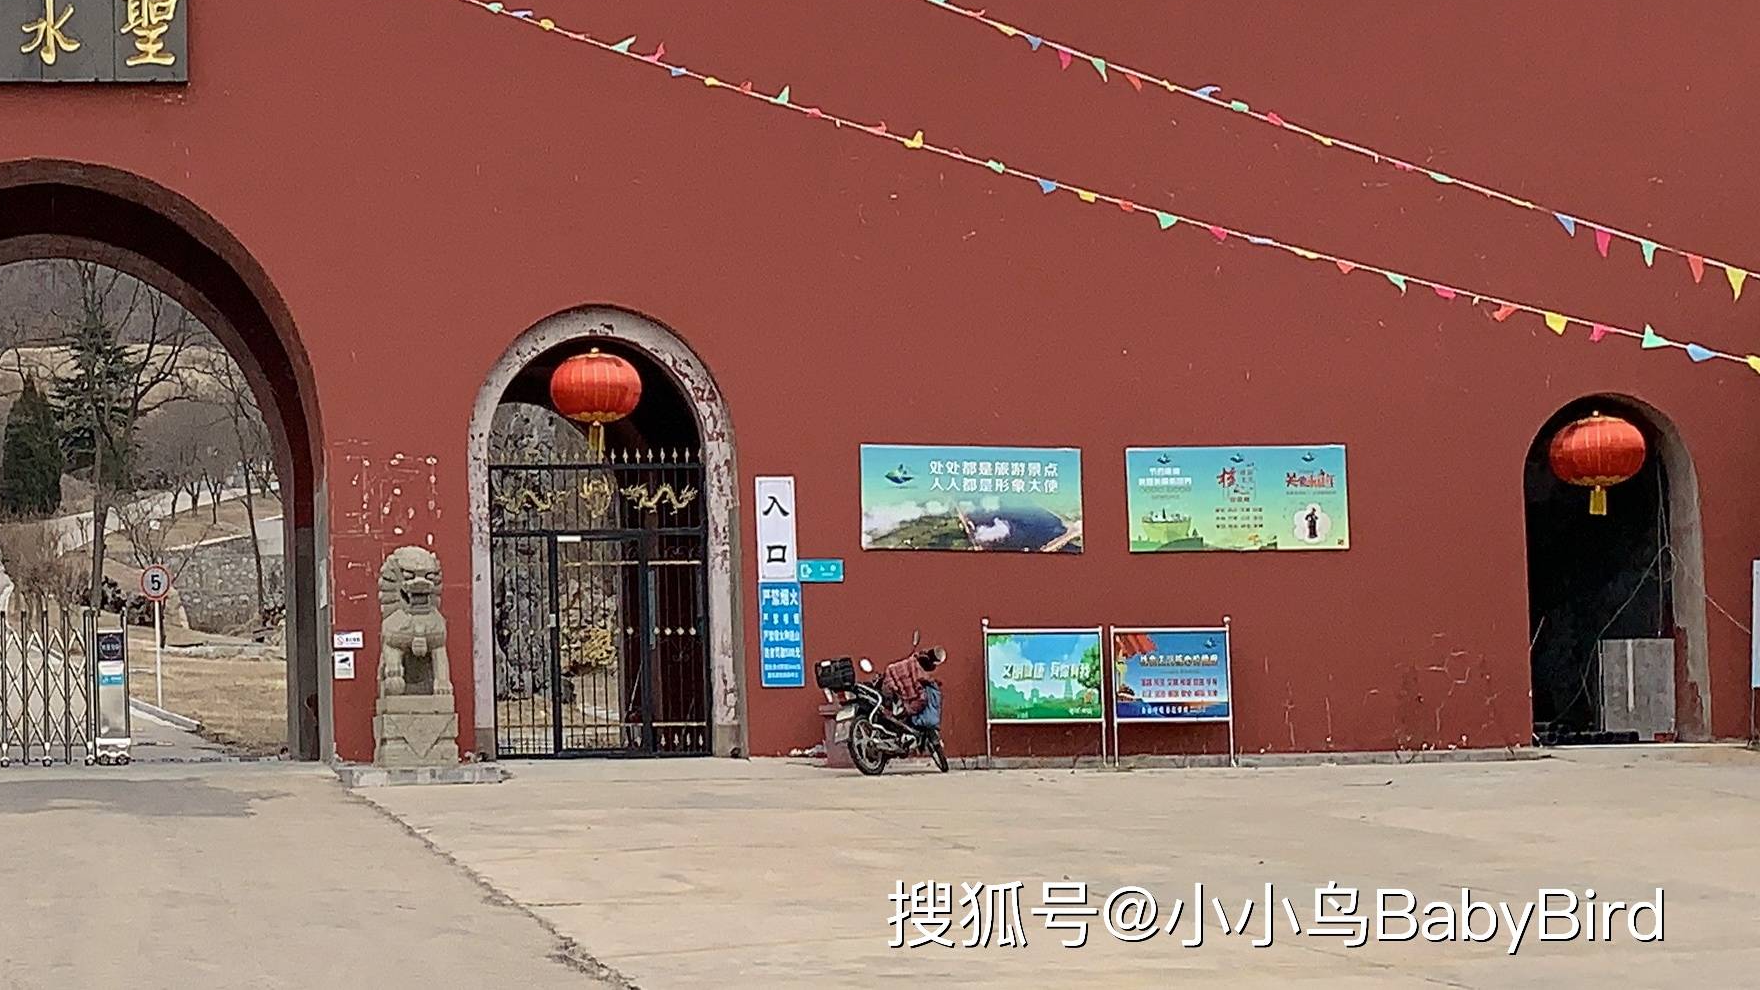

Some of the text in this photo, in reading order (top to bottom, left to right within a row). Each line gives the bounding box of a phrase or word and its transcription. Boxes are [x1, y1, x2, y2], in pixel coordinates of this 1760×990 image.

[929, 460, 1059, 477] 处处都是旅游景点
[929, 477, 1059, 493] 人人都是形象大使
[762, 495, 789, 563] 入口
[151, 574, 161, 591] 5
[762, 589, 799, 607] 严禁烟火
